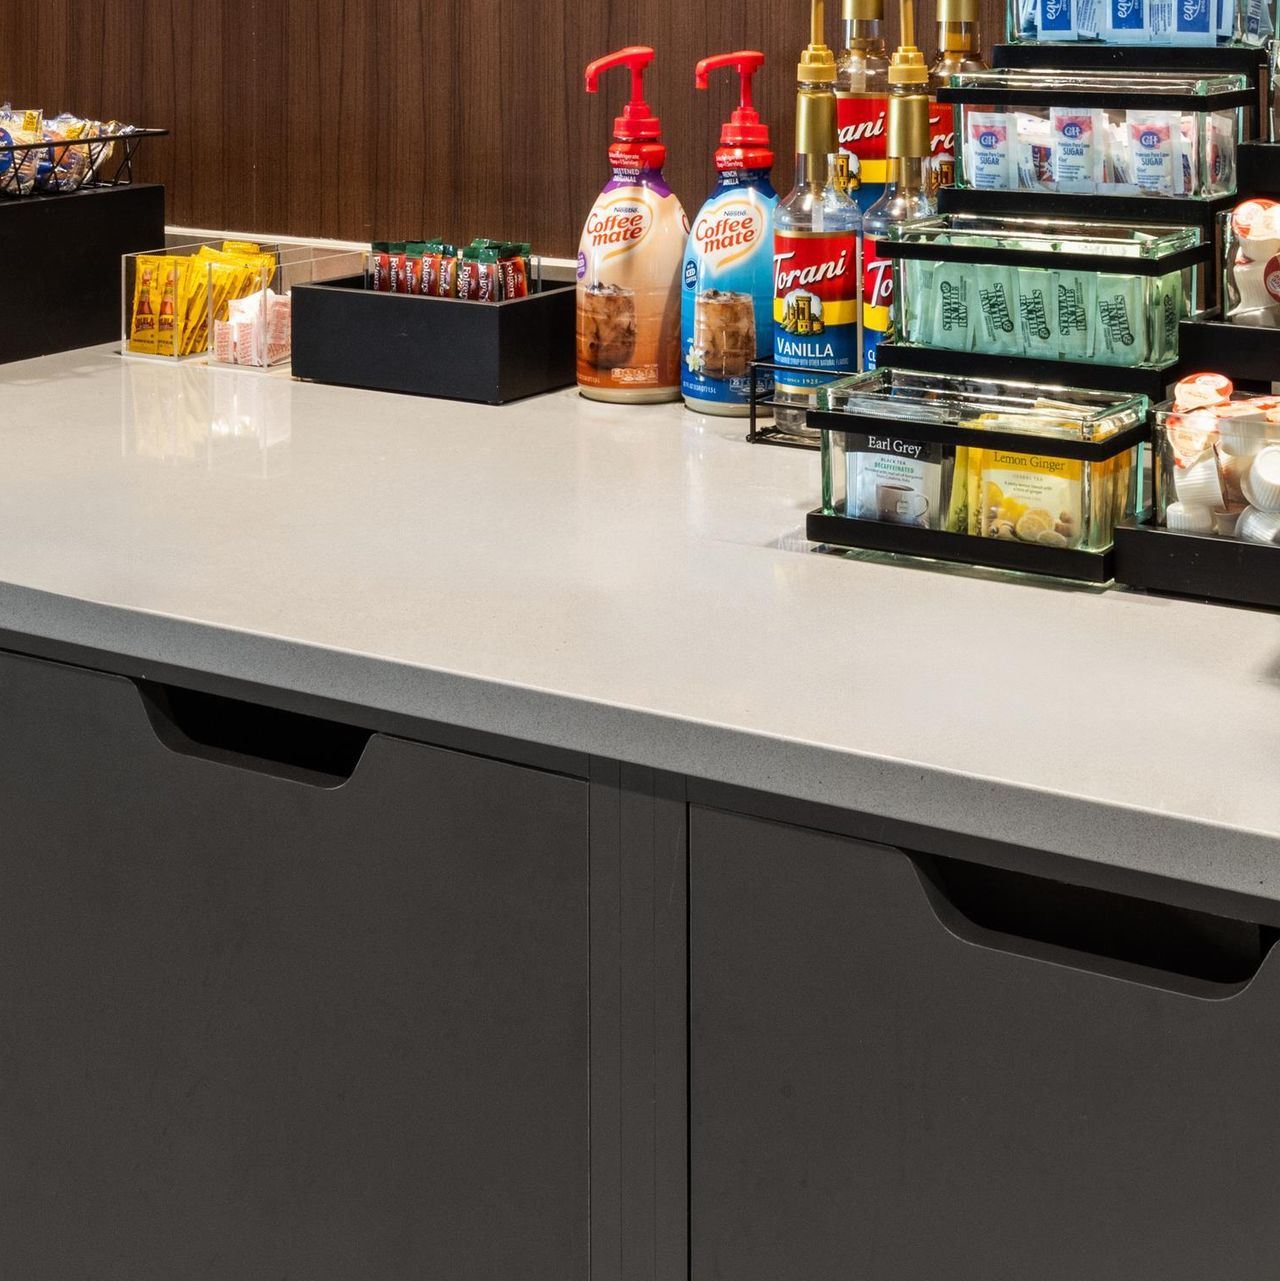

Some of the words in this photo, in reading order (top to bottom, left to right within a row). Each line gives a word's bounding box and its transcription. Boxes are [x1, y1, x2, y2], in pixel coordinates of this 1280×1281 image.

[980, 156, 1000, 166] SUGAR
[1063, 148, 1083, 156] SUGAR
[1141, 157, 1163, 166] SUGAR
[587, 213, 644, 235] Coffee
[696, 217, 753, 241] Coffee
[592, 226, 643, 247] mate
[704, 231, 754, 254] mate
[422, 257, 431, 293] Folgers
[507, 262, 515, 297] Folgers
[774, 250, 847, 299] Torani
[777, 337, 834, 357] VANILLA
[868, 436, 890, 450] Earl
[893, 440, 922, 458] Grey
[875, 462, 914, 474] DECAFFEINATED
[994, 452, 1027, 466] Lemon
[1030, 456, 1066, 472] Ginger
